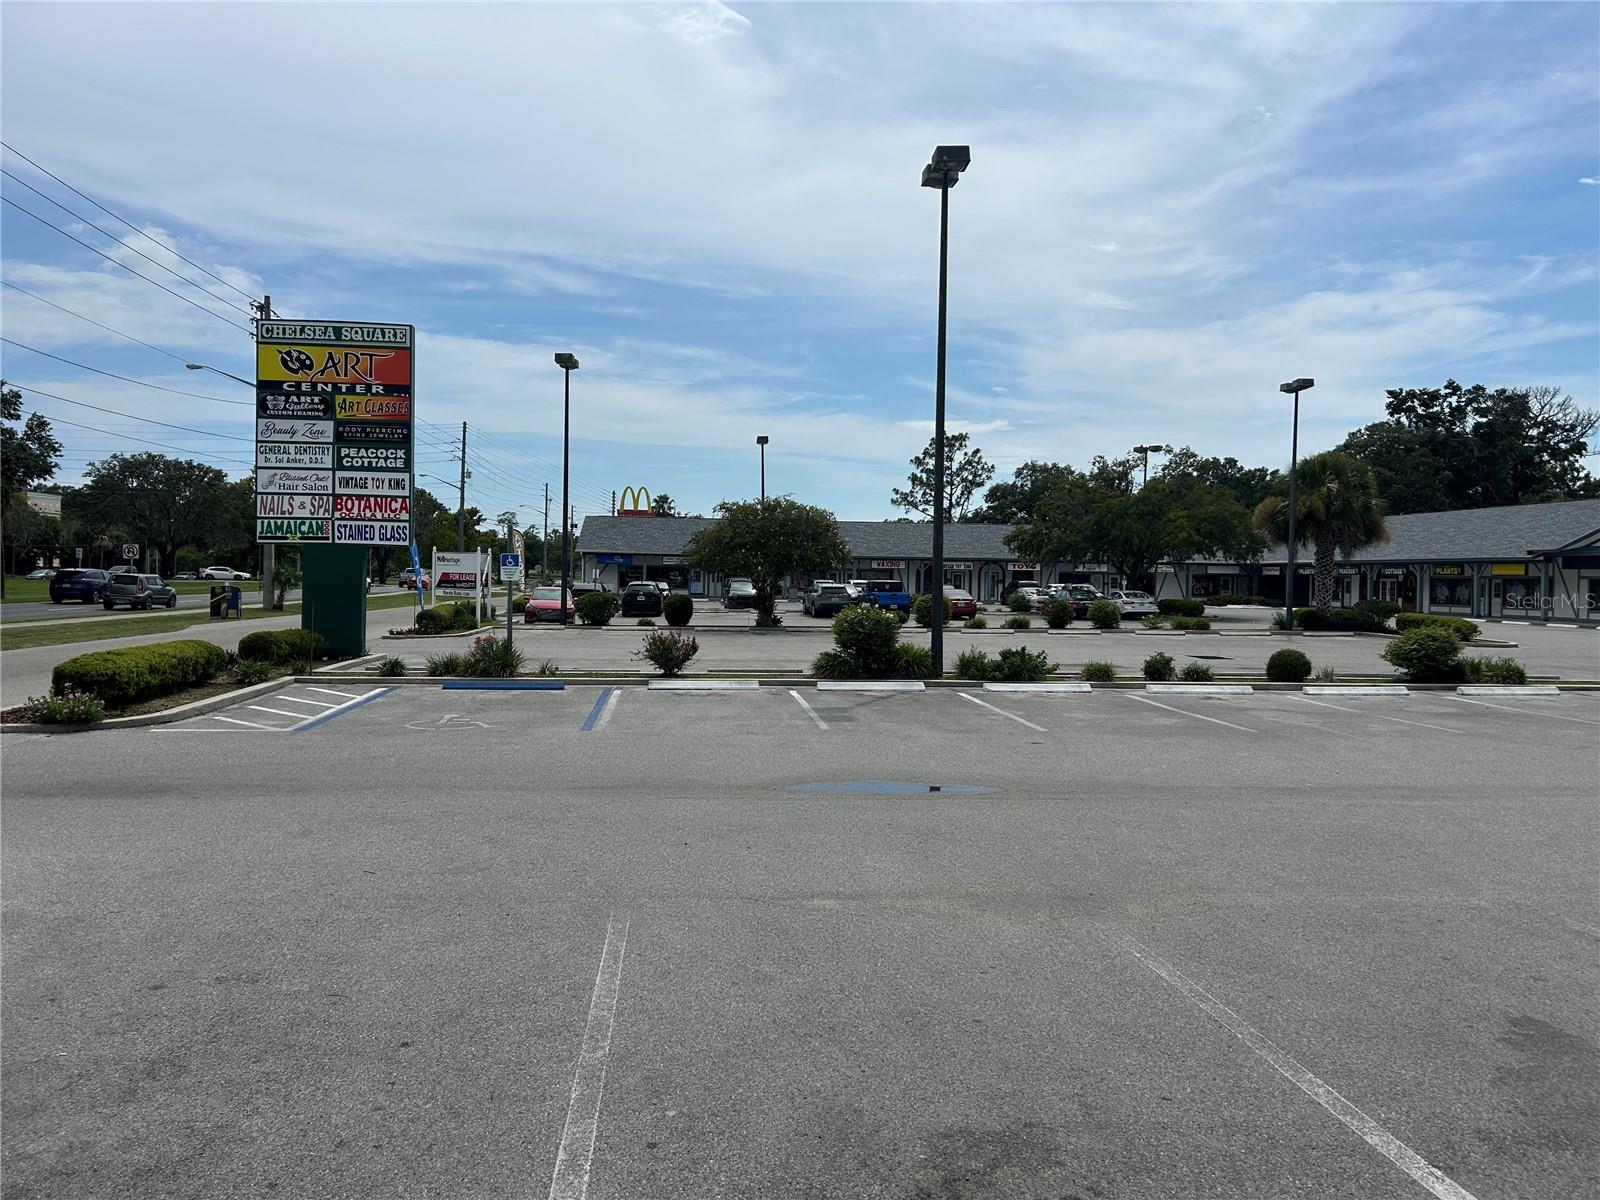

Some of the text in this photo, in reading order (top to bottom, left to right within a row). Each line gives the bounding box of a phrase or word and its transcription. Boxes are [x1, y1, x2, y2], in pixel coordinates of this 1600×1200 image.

[262, 324, 406, 342] CHELSEA SQUARE
[310, 351, 396, 384] ART
[282, 382, 385, 394] CENTER
[285, 402, 325, 411] Gallery
[261, 421, 328, 440] Beauty Zone
[258, 444, 331, 456] GENERAL DENTISTRY
[340, 447, 406, 458] PEACOCK
[275, 456, 284, 464] Sol
[286, 456, 307, 465] Anker,
[342, 457, 405, 468] COTTAGE
[309, 473, 330, 482] Out!
[278, 482, 329, 491] Hair Salon
[338, 476, 406, 491] VINTAGE TOY KING
[259, 495, 331, 516] NAILS & SPA
[335, 495, 409, 514] BOTANICA
[339, 511, 401, 520] OCALA LLC
[259, 520, 324, 536] JAMAICAN
[336, 523, 408, 542] STAINED GLASS
[876, 560, 901, 568] WAXING
[1436, 567, 1458, 575] PLANTS
[450, 573, 476, 581] FOR LEASE
